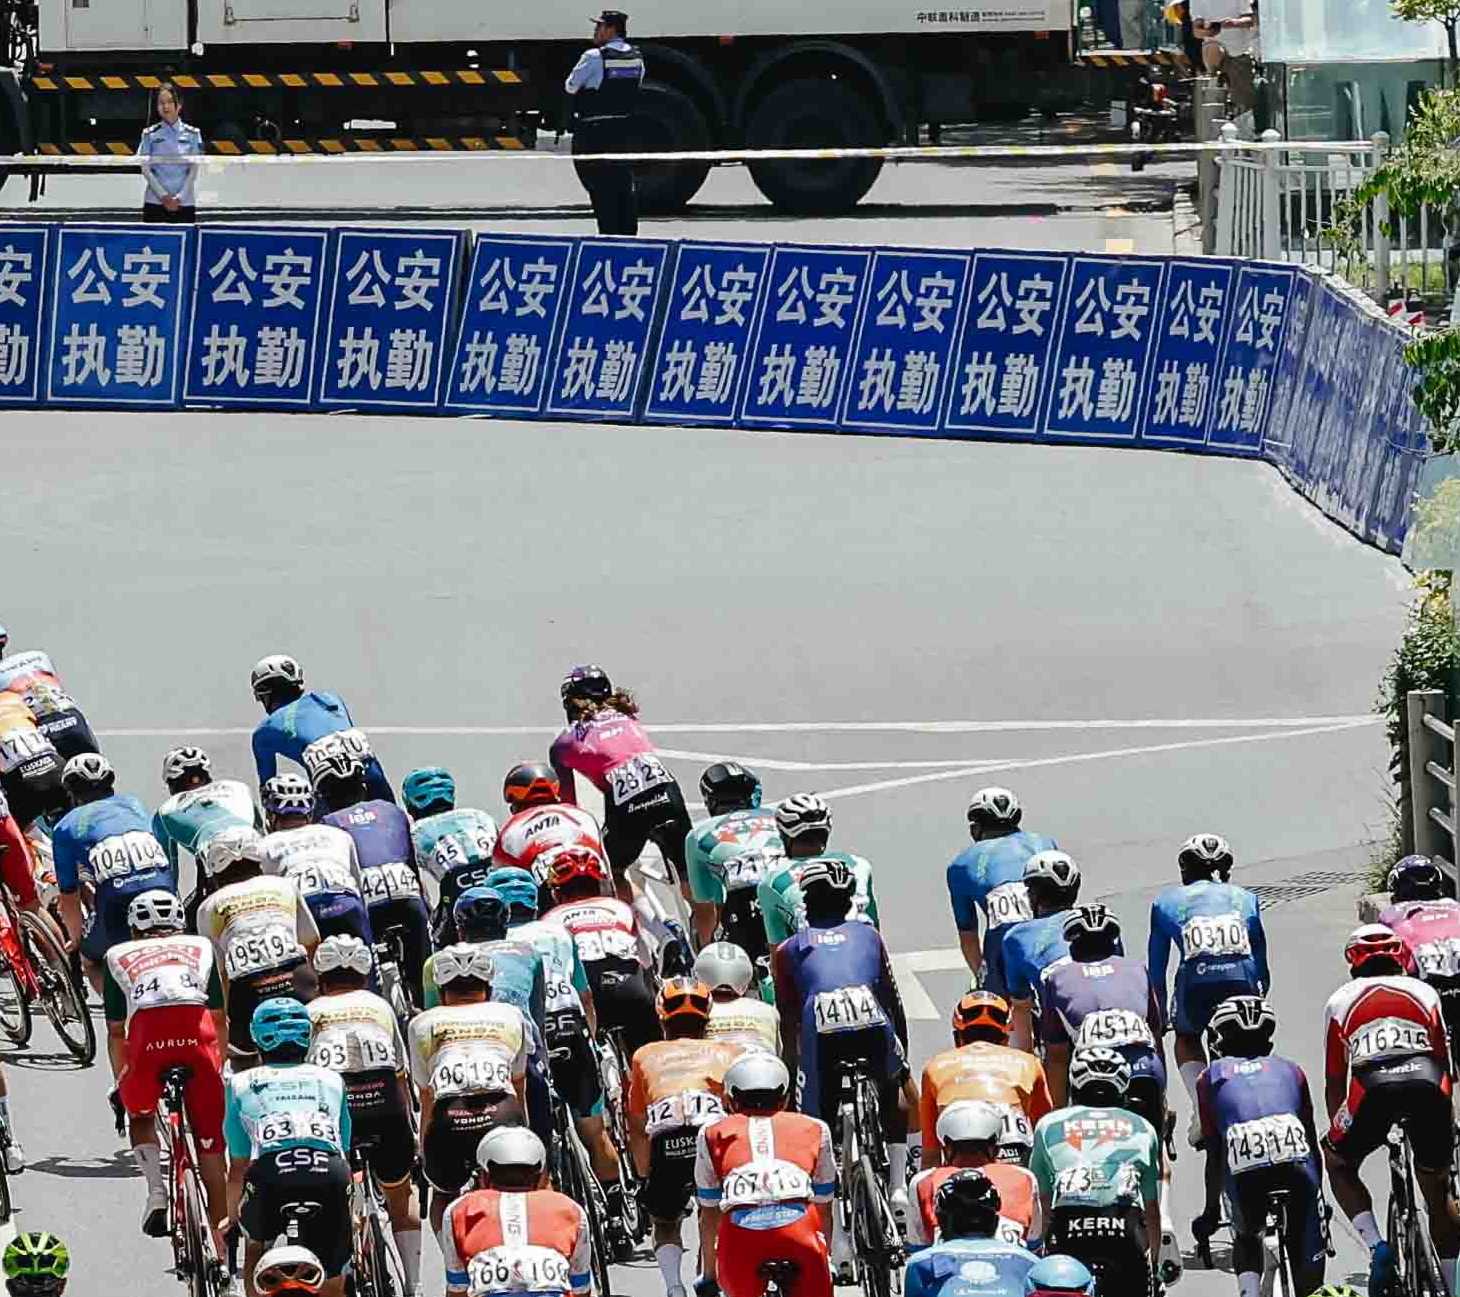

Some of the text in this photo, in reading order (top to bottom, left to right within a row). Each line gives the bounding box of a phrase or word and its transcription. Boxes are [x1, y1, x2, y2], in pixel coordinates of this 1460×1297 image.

[69, 245, 170, 309] 公安
[209, 247, 311, 309] 公安
[346, 248, 444, 311] 公安
[480, 255, 555, 318] 公安
[582, 258, 655, 321] 公安
[682, 258, 756, 327] 公安
[777, 263, 857, 331] 公安
[879, 267, 955, 333] 公安
[978, 272, 1052, 336] 公安
[1076, 276, 1151, 341] 公安
[1170, 279, 1224, 343] 公安
[1236, 287, 1283, 349] 公安
[63, 326, 166, 388] 执勤
[202, 324, 305, 388] 执勤
[338, 327, 433, 391] 执勤
[461, 333, 544, 396] 执勤
[562, 337, 637, 403] 执勤
[662, 341, 737, 406] 执勤
[758, 344, 840, 409] 执勤
[860, 349, 936, 414] 执勤
[961, 351, 1037, 418] 执勤
[1060, 357, 1136, 422] 执勤
[1157, 360, 1209, 427] 执勤
[1220, 368, 1269, 434] 执勤
[524, 816, 560, 840] ANTA
[92, 849, 126, 875] 104
[146, 1038, 198, 1051] AURUM
[263, 1120, 336, 1139] 63 63
[692, 1093, 719, 1115] 12
[275, 1150, 329, 1172] CSF
[1230, 1124, 1265, 1158] 143
[1068, 1215, 1126, 1232] KERN
